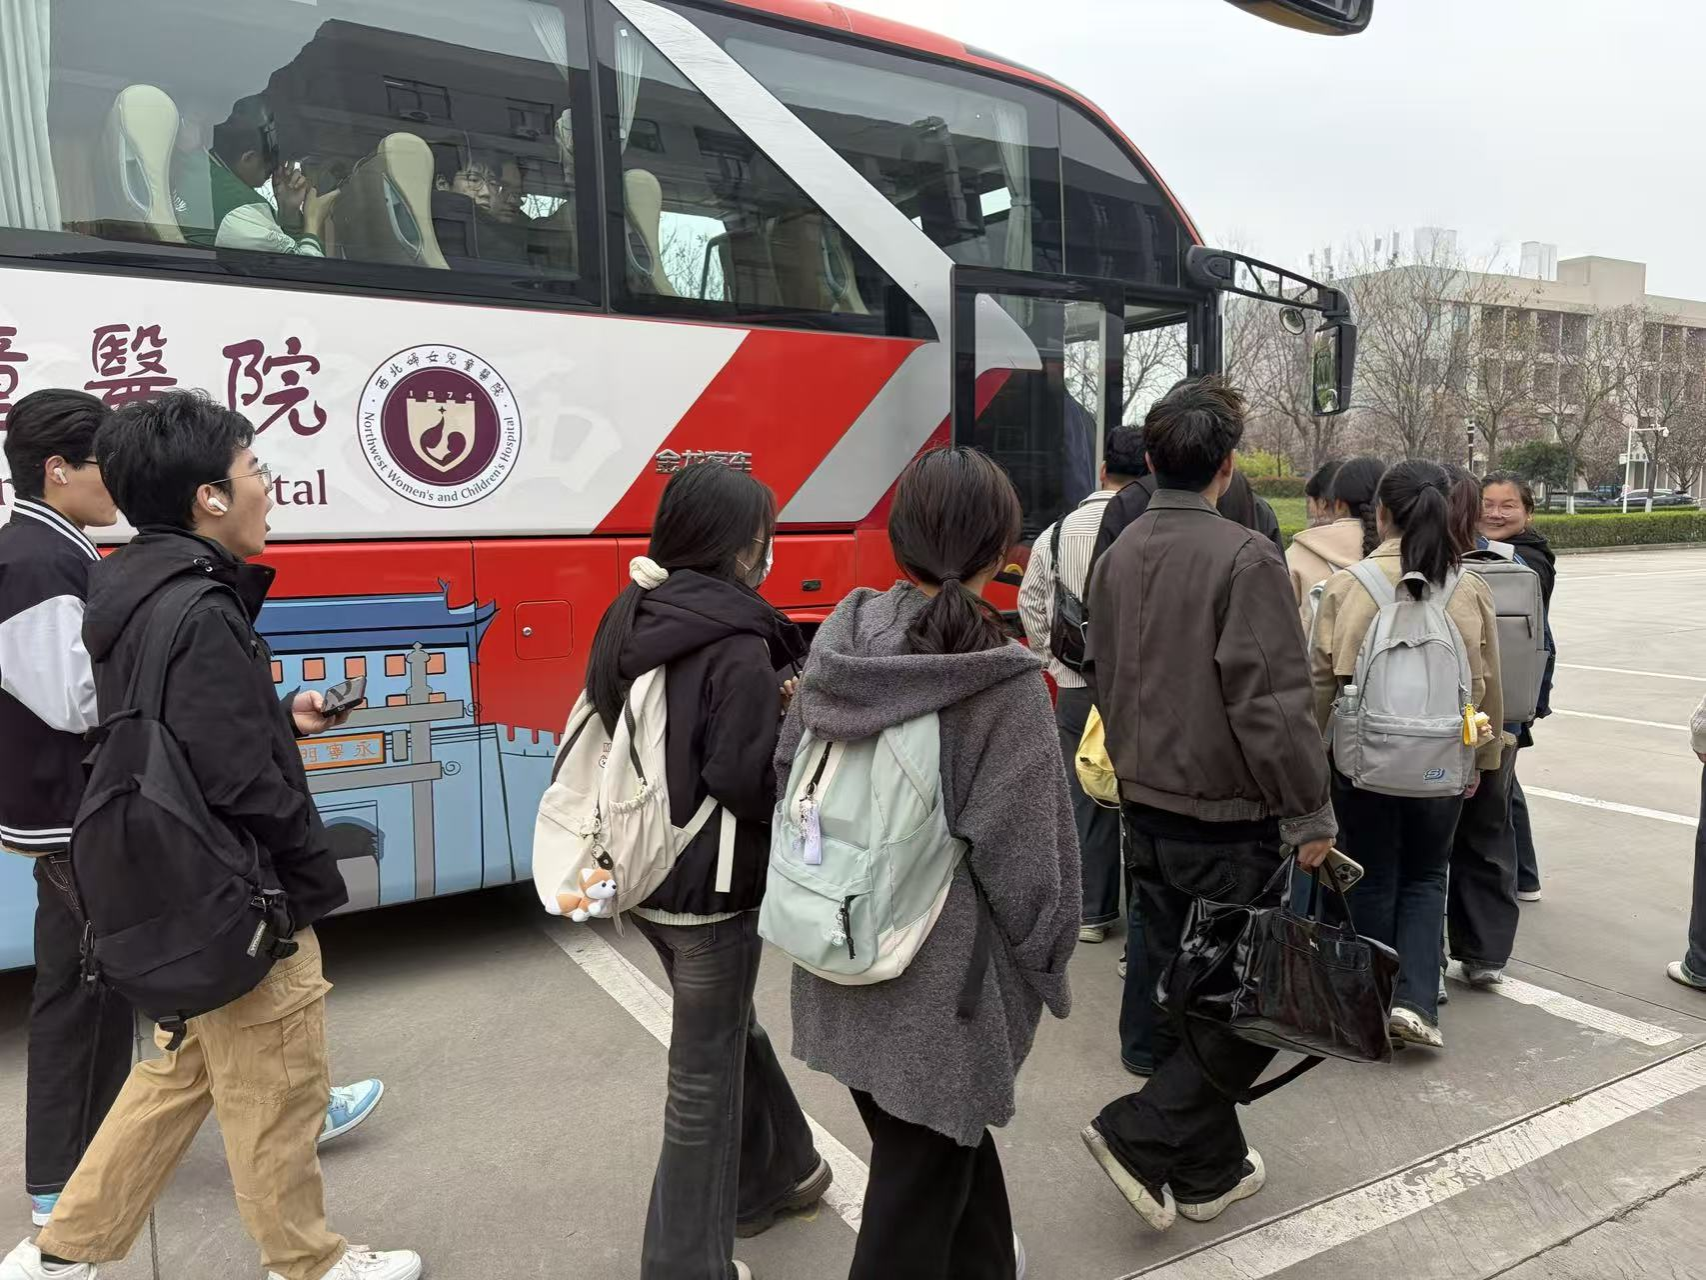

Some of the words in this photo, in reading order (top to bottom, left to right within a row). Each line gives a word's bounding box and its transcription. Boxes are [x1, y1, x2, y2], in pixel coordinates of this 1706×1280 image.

[408, 390, 473, 399] 1974
[364, 412, 388, 472] Northwest
[387, 469, 434, 501] Women's
[437, 491, 459, 502] and
[461, 464, 506, 499] Children's
[500, 416, 517, 463] Hospital
